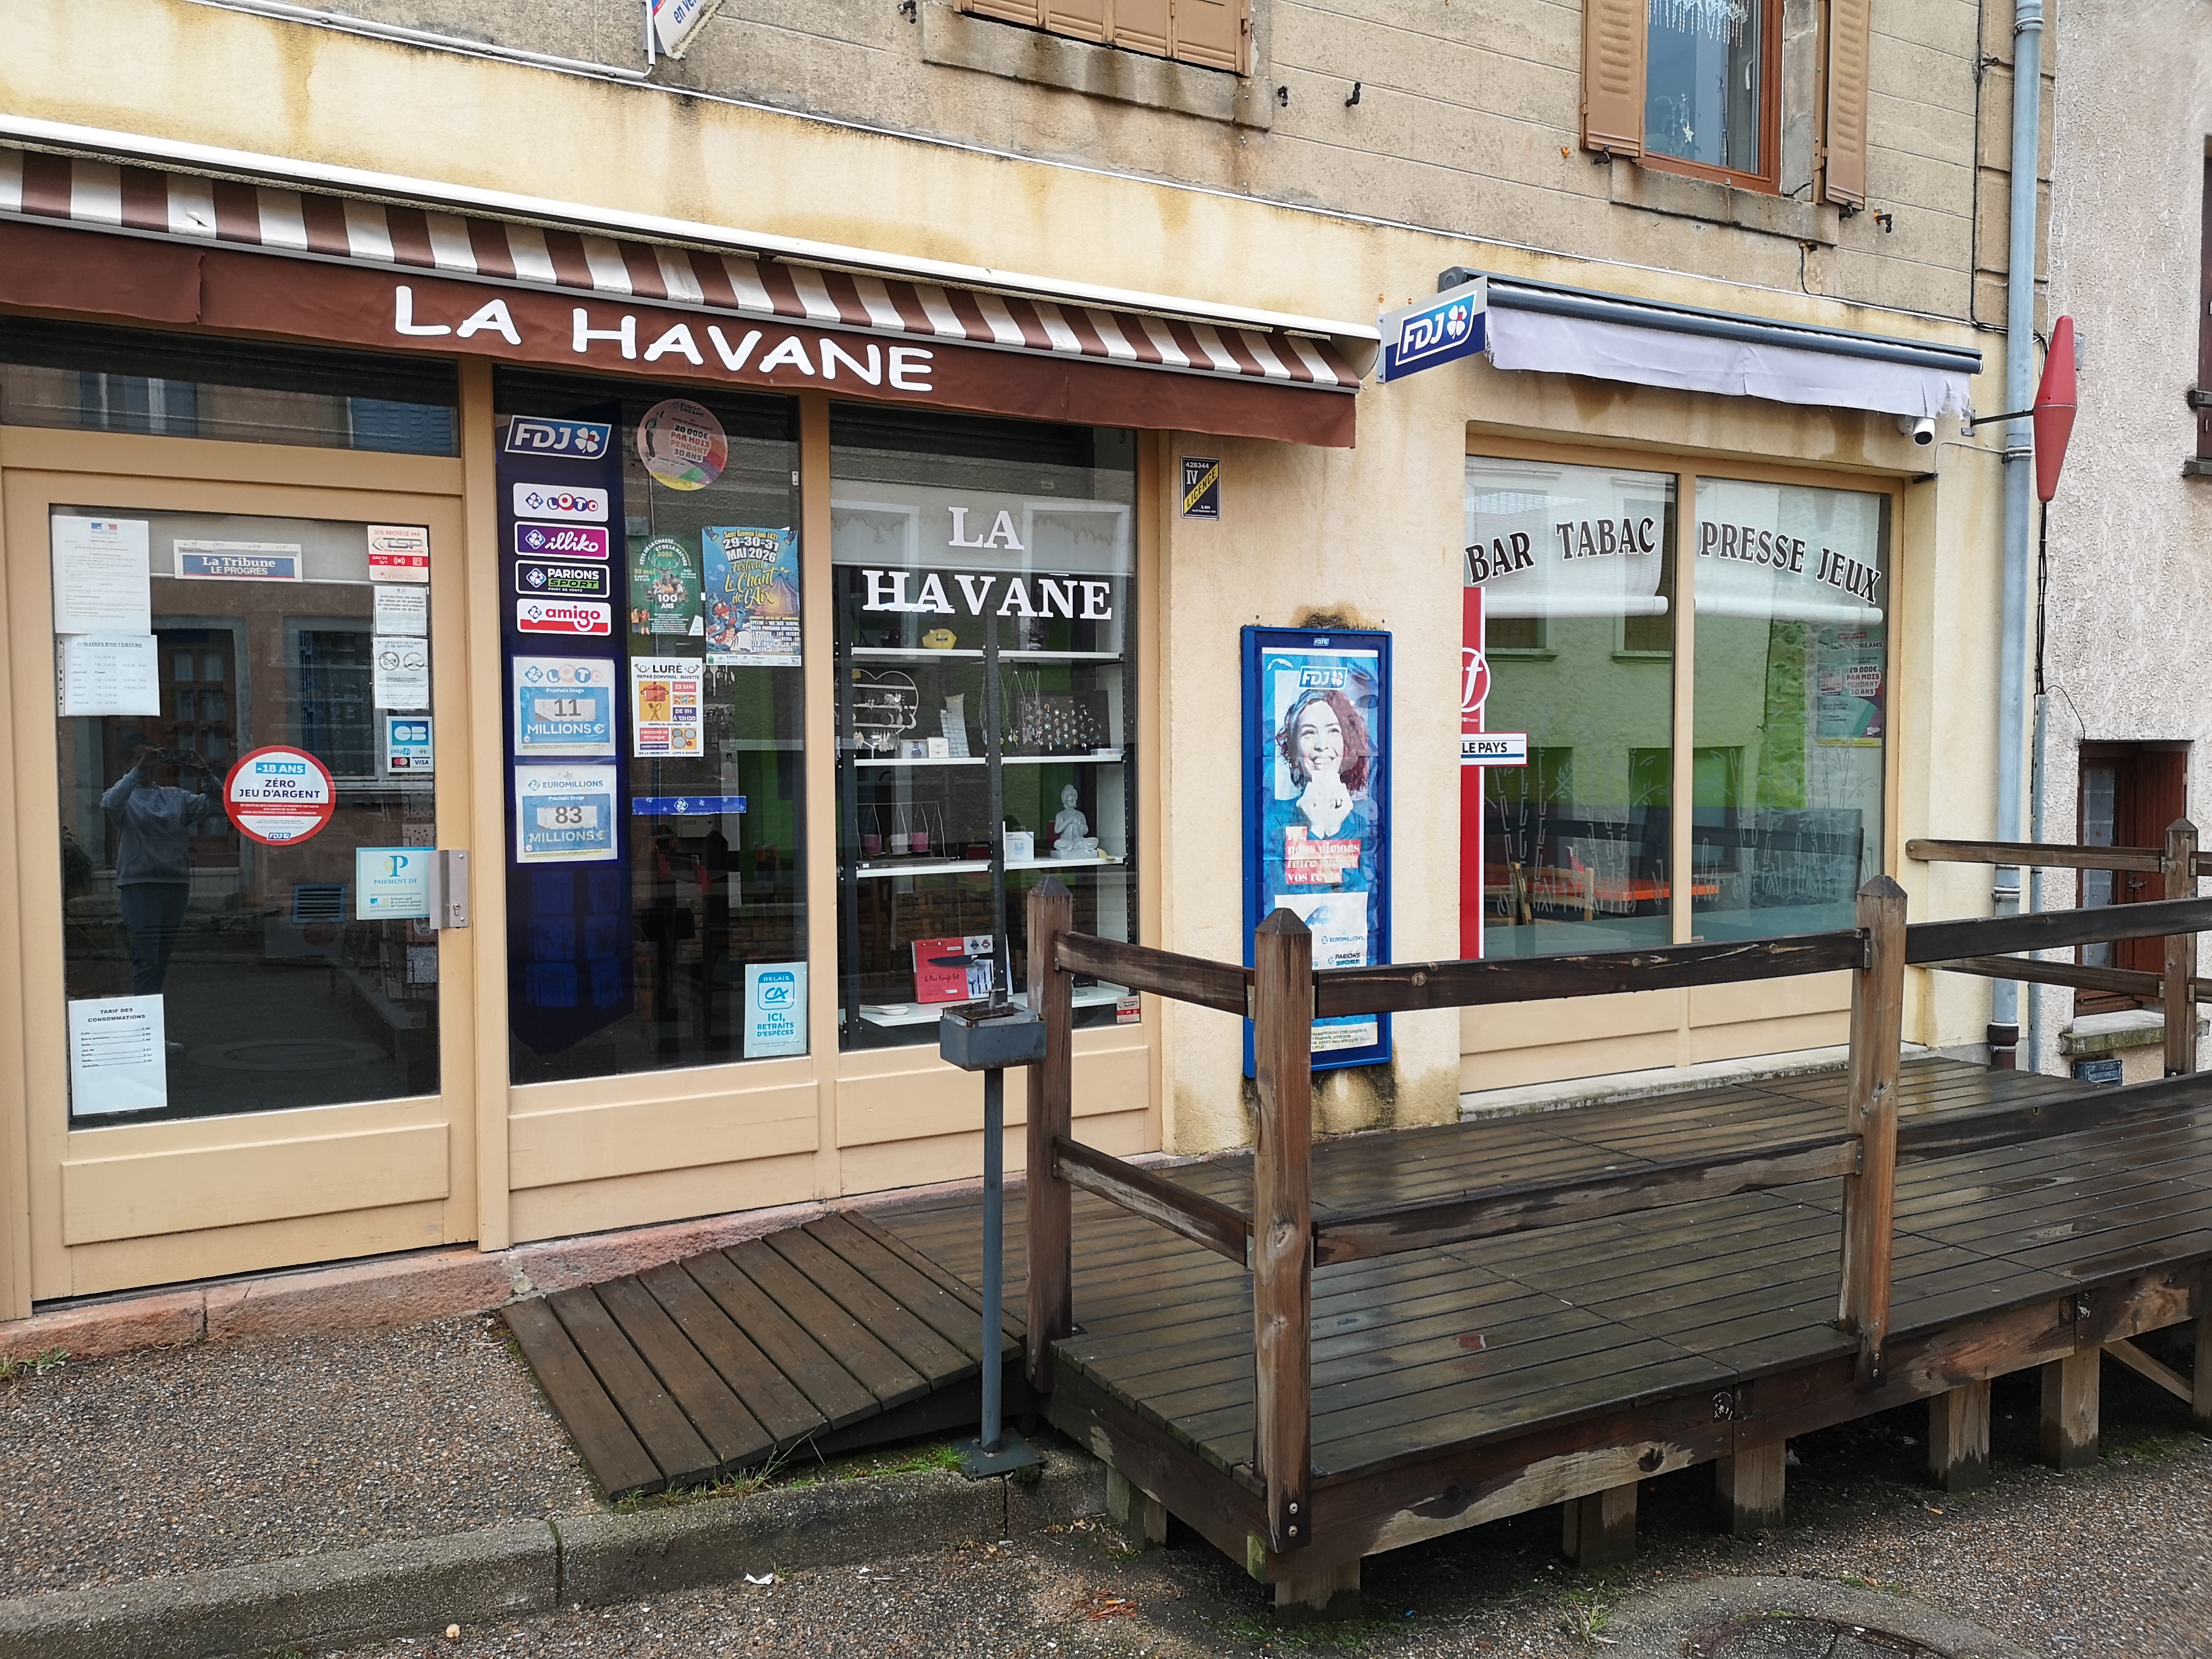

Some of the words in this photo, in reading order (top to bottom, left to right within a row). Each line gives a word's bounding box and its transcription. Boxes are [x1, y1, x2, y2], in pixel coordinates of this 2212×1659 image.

[395, 285, 521, 346] LA
[572, 307, 933, 392] HAVANE
[1402, 312, 1446, 355] FDJ
[680, 402, 697, 411] EURO
[680, 407, 705, 418] DREAMS
[514, 423, 572, 450] FDJ
[674, 424, 686, 434] 20
[670, 439, 708, 455] PENDANT
[671, 432, 688, 442] PAR
[688, 436, 710, 447] MOIS
[674, 448, 685, 457] 30
[685, 450, 702, 461] ANS
[1185, 470, 1199, 484] IV
[1187, 468, 1216, 508] LICENCE
[547, 493, 598, 512] LOTO
[948, 506, 1025, 551] LA
[383, 537, 424, 549] TSP
[545, 531, 599, 552] illiko
[722, 536, 780, 552] 29-30-31
[202, 557, 220, 566] La
[222, 558, 276, 568] Tribune
[675, 548, 688, 567] NATURE
[749, 548, 777, 563] 2026
[1465, 531, 1535, 586] BAR
[1555, 516, 1657, 560] TABAC
[1698, 520, 1807, 574] PRESSE
[1815, 547, 1881, 604] JEUX
[731, 558, 764, 574] Festival
[547, 568, 600, 580] PARIONS
[724, 574, 736, 593] Le
[737, 566, 779, 594] Chant
[549, 579, 598, 588] SPORT
[657, 594, 678, 603] 100
[732, 592, 743, 604] de
[744, 586, 775, 609] l'Aix
[862, 569, 1112, 620] HAVANE
[545, 605, 601, 629] amigo
[547, 664, 603, 683] LOTO
[652, 663, 683, 674] LURÉ
[1301, 670, 1330, 686] FDJ
[554, 699, 581, 717] 11
[394, 725, 427, 741] CB
[527, 723, 591, 734] MILLIONS
[593, 725, 605, 734] €
[1462, 742, 1476, 754] LE
[1478, 742, 1507, 754] PAYS
[257, 765, 276, 773] -18
[278, 765, 304, 774] ANS
[264, 778, 296, 788] ZÉRO
[263, 790, 321, 799] D'ARGENT
[555, 806, 583, 824] 83
[529, 831, 595, 843] MILLIONS
[389, 855, 409, 877] P
[1287, 874, 1308, 882] vos
[765, 987, 789, 1000] CA
[88, 1014, 146, 1023] CONSOMMATIONS
[768, 1013, 786, 1022] ICI,
